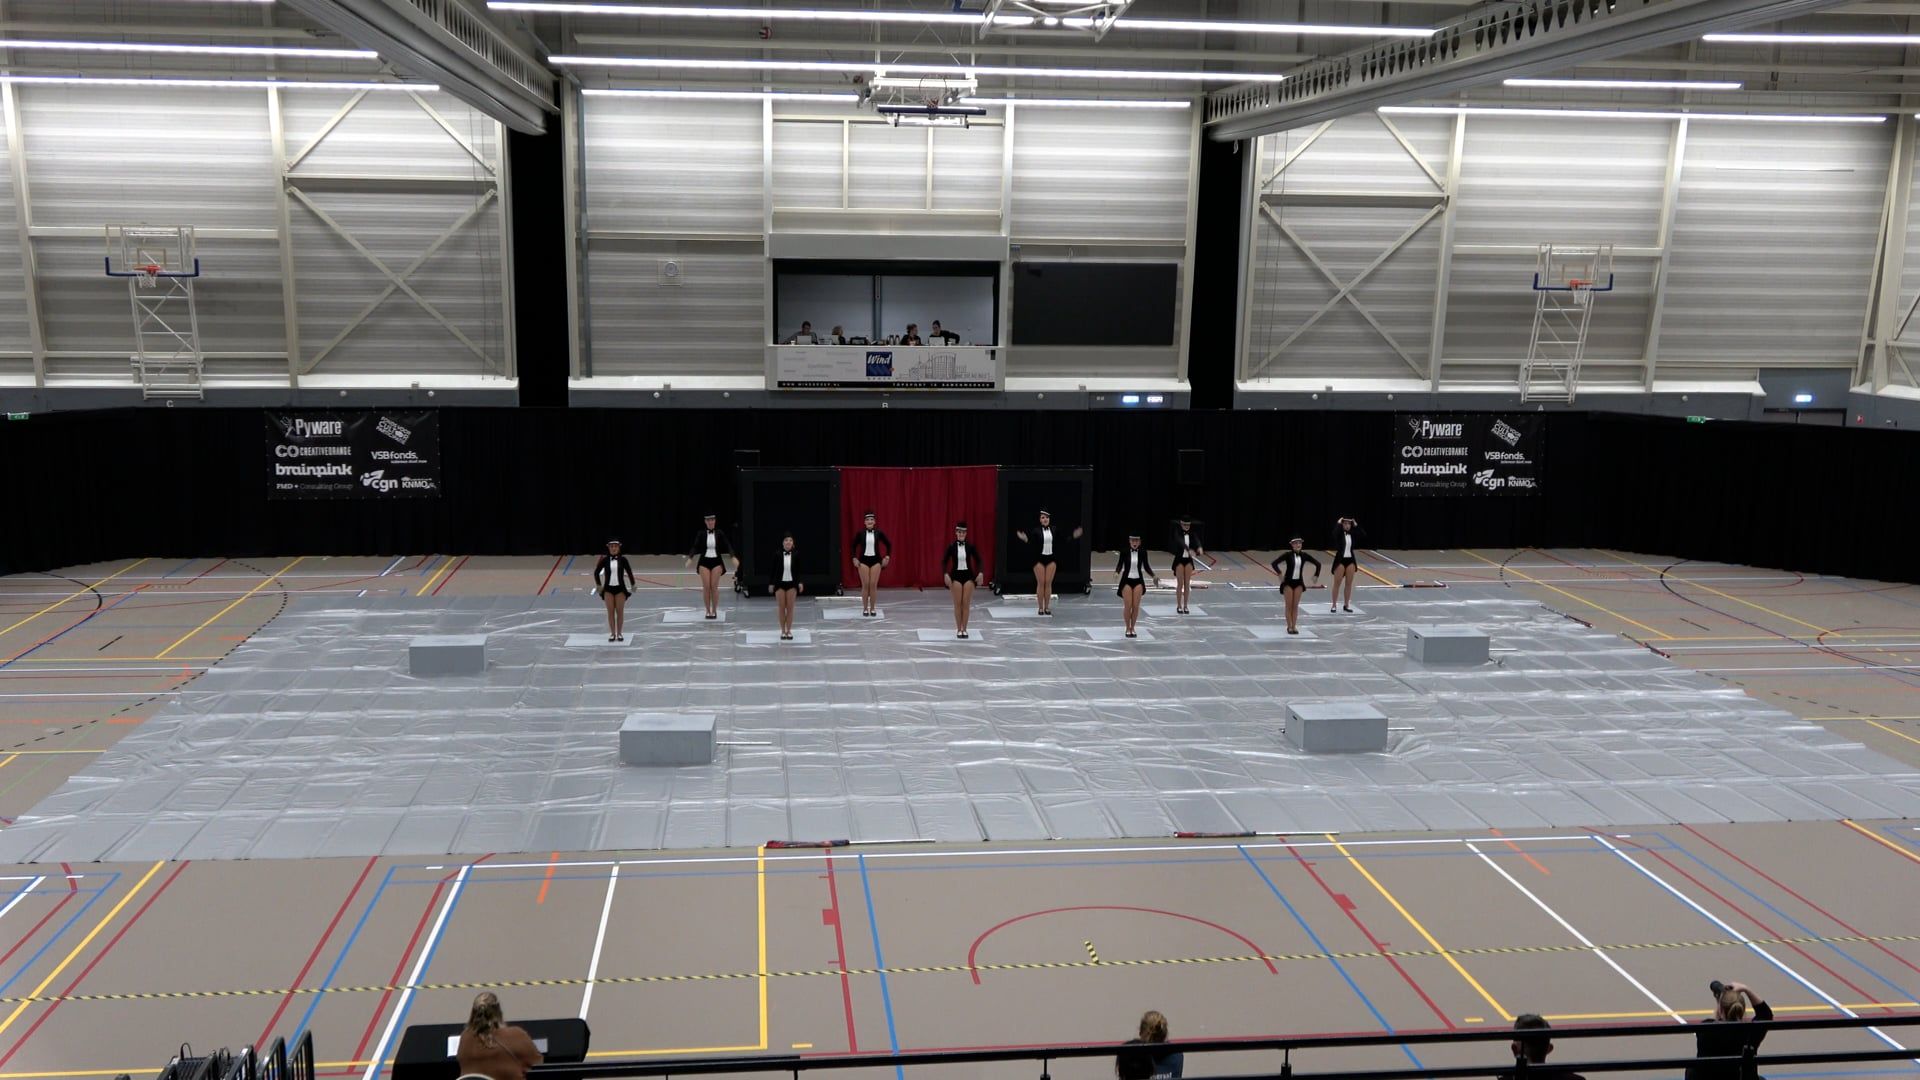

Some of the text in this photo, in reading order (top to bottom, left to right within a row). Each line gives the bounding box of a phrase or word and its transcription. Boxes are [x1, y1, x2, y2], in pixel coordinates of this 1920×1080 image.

[867, 354, 892, 364] Wind
[295, 418, 342, 438] Pyware
[1422, 420, 1462, 439] Pyware
[276, 463, 352, 478] brainpink
[1400, 462, 1467, 477] brainpink
[372, 479, 398, 492] cgn
[1482, 478, 1505, 490] cgn
